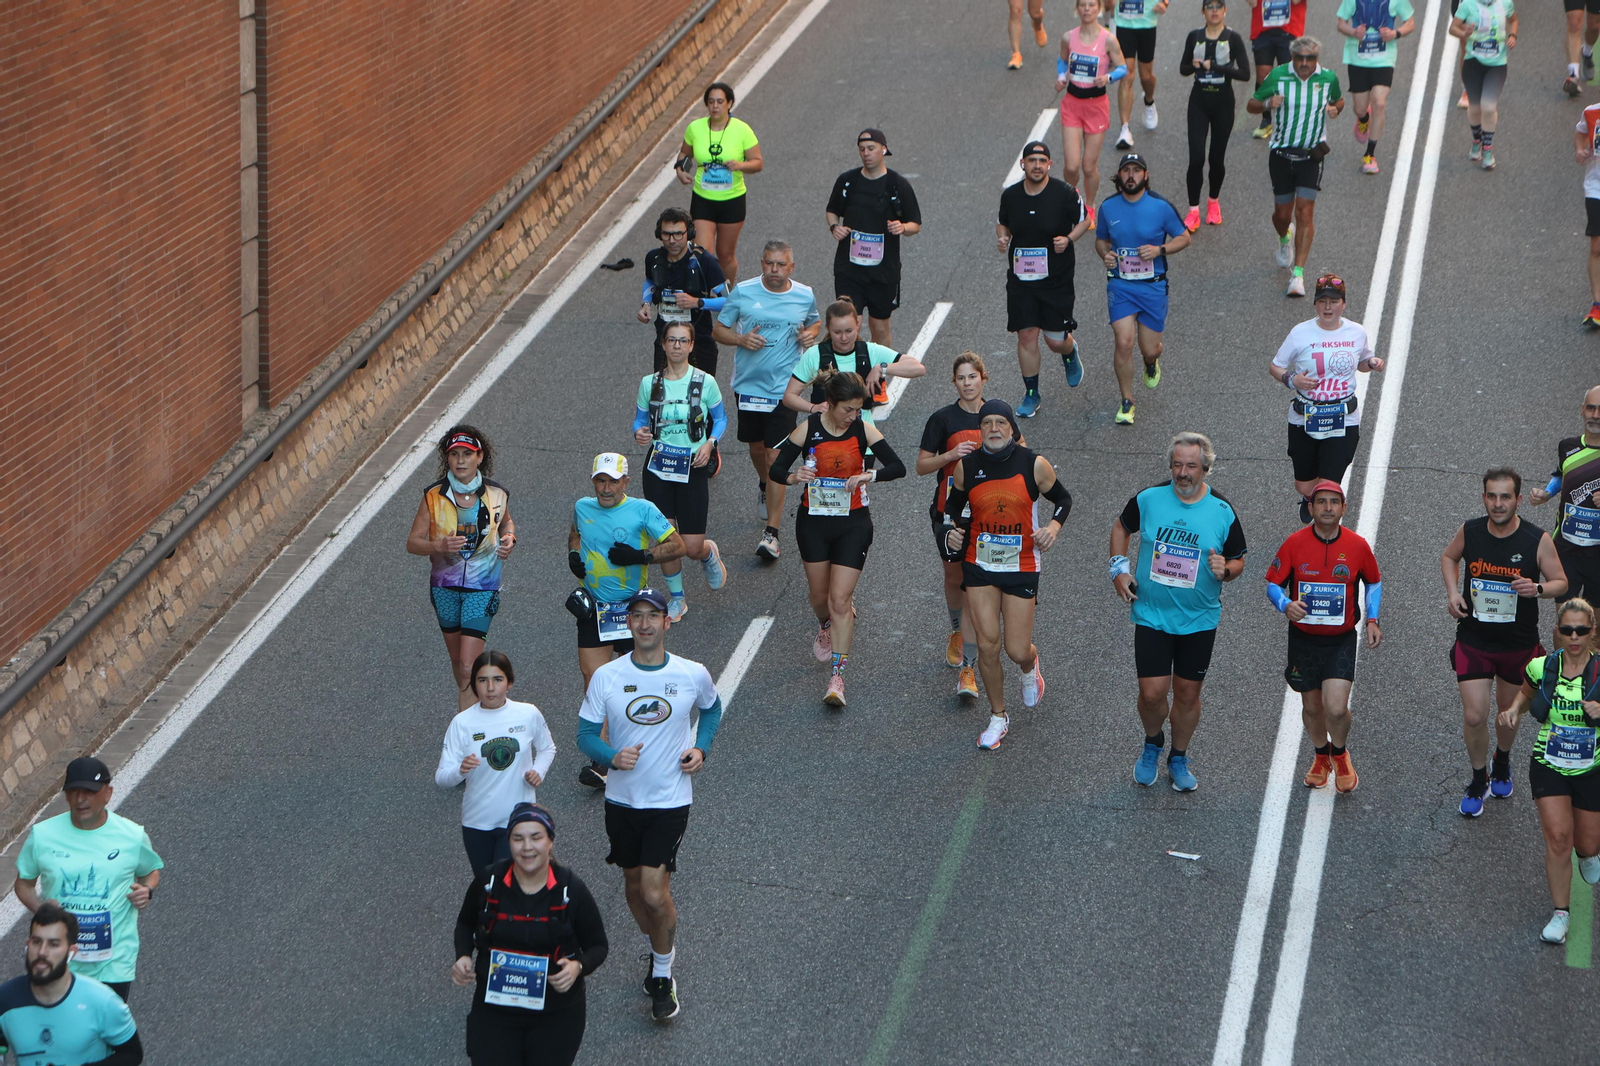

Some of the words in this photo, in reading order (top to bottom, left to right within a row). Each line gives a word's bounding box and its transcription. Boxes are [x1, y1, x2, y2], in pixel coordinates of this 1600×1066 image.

[665, 446, 687, 454] ZURICH
[993, 536, 1017, 544] ZURICH
[1173, 529, 1200, 546] TRAIL
[1169, 548, 1194, 557] ZURICH
[1166, 560, 1182, 570] 6820
[1157, 567, 1178, 577] IGNACIO
[1486, 584, 1512, 592] ZURICH
[1485, 597, 1500, 605] 9563
[77, 916, 106, 924] ZURICH
[509, 957, 540, 968] ZURICH
[505, 974, 528, 985] 12904
[502, 985, 529, 996] MARGUE
